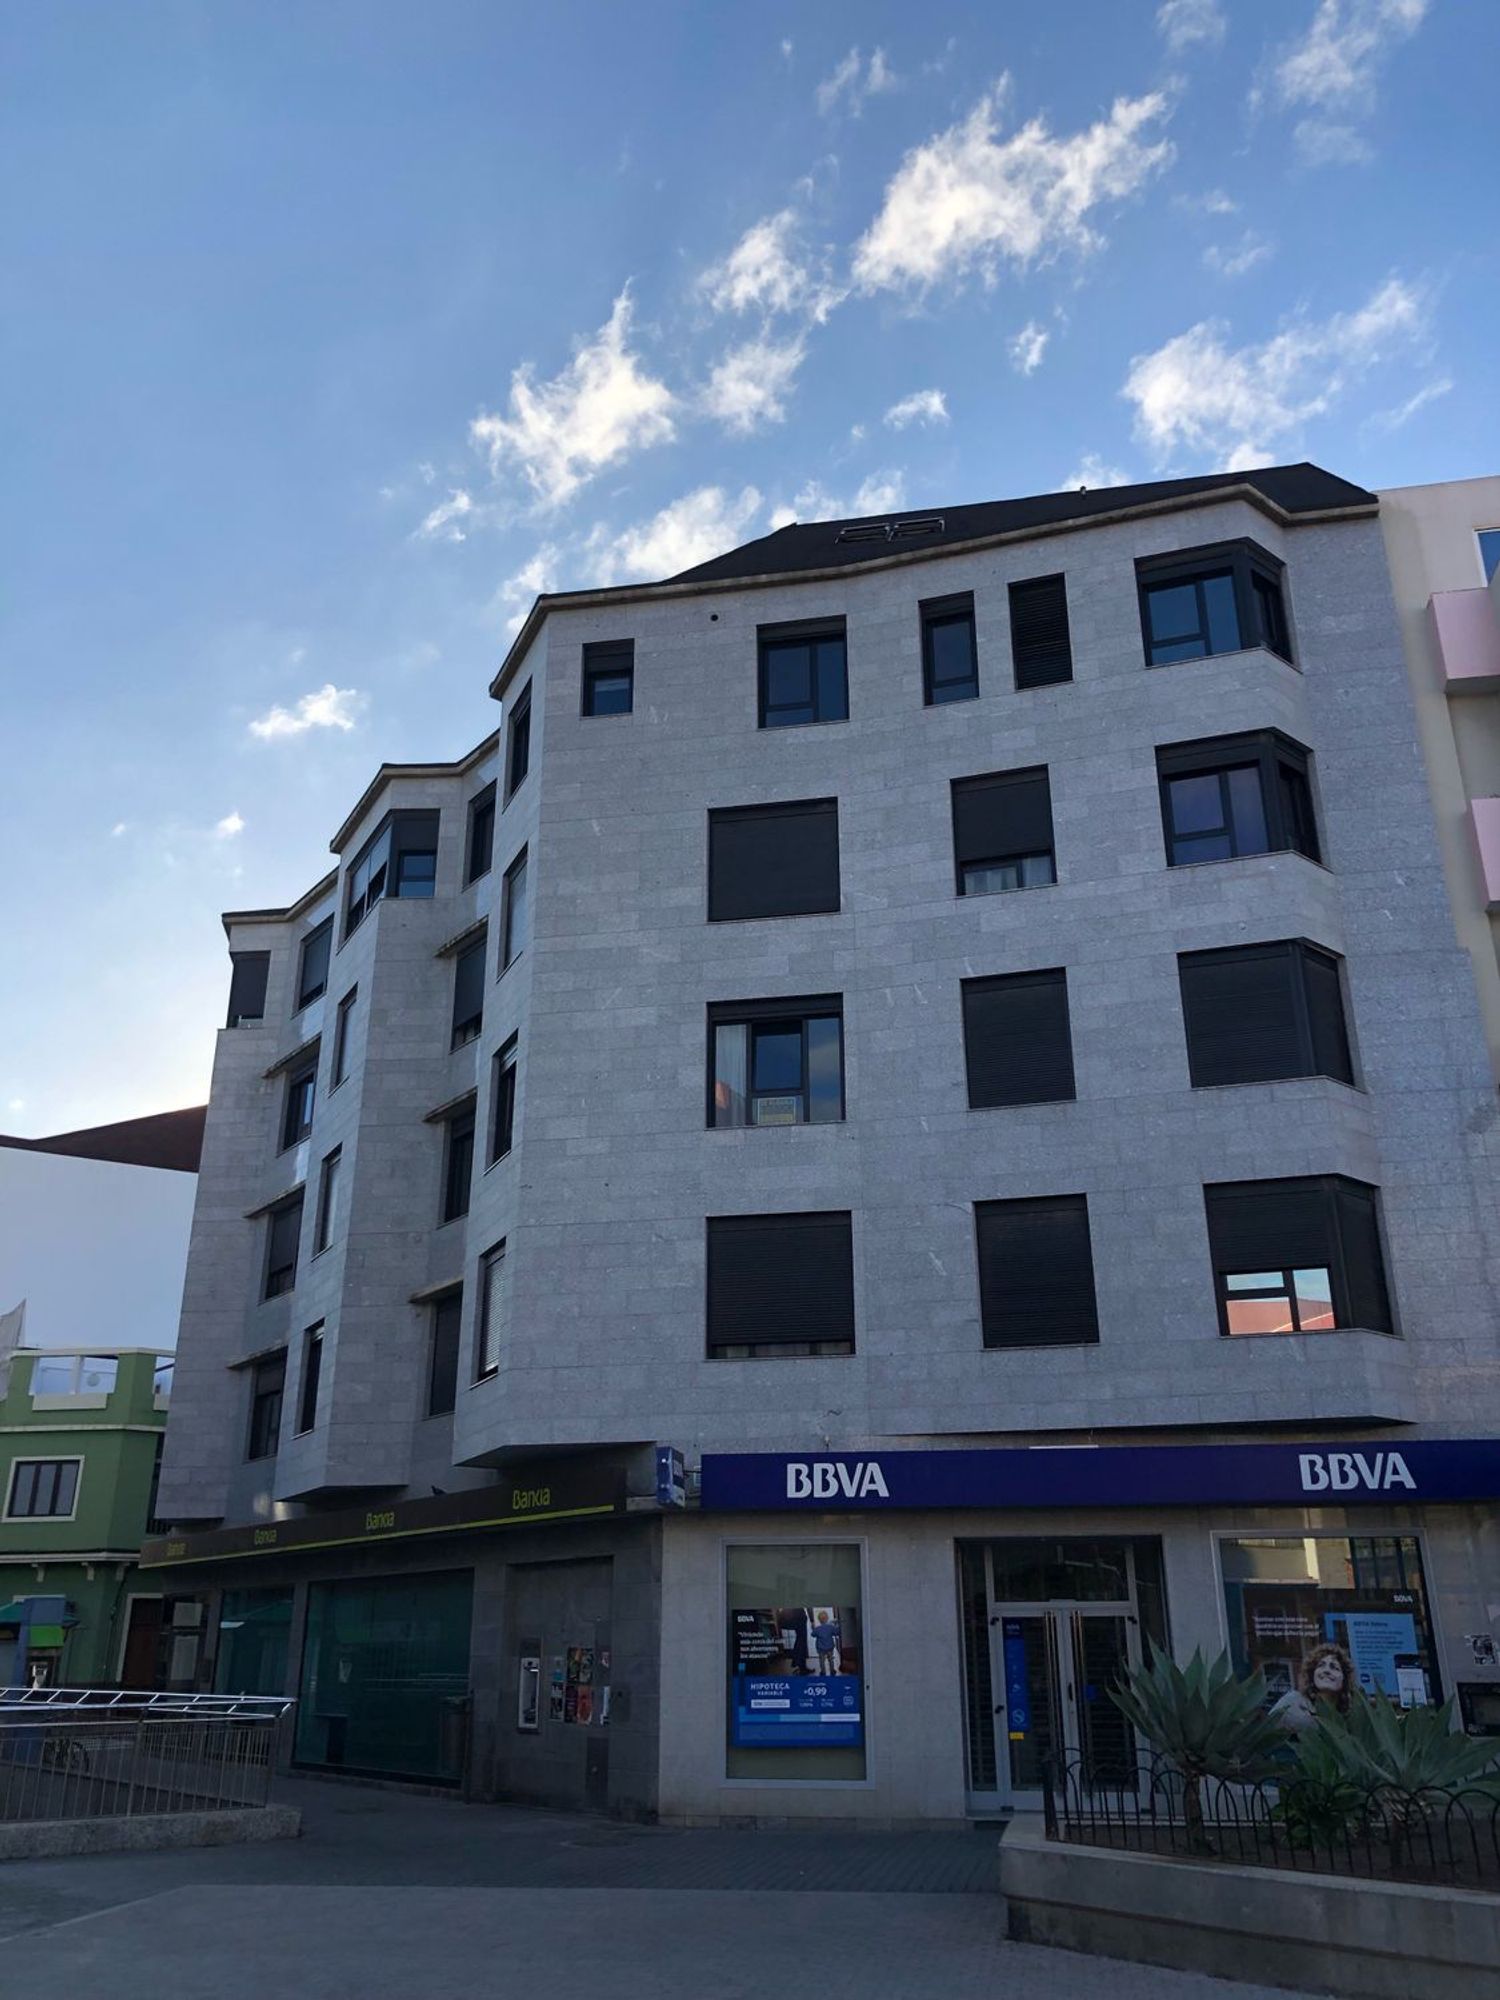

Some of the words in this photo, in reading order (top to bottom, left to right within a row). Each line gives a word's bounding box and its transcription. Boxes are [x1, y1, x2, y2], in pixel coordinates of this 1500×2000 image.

[786, 1462, 890, 1498] BBVA
[1298, 1452, 1417, 1491] BBVA
[512, 1487, 551, 1510] Bankia
[365, 1511, 395, 1530] Bankia
[750, 1682, 790, 1690] HIPOTECA
